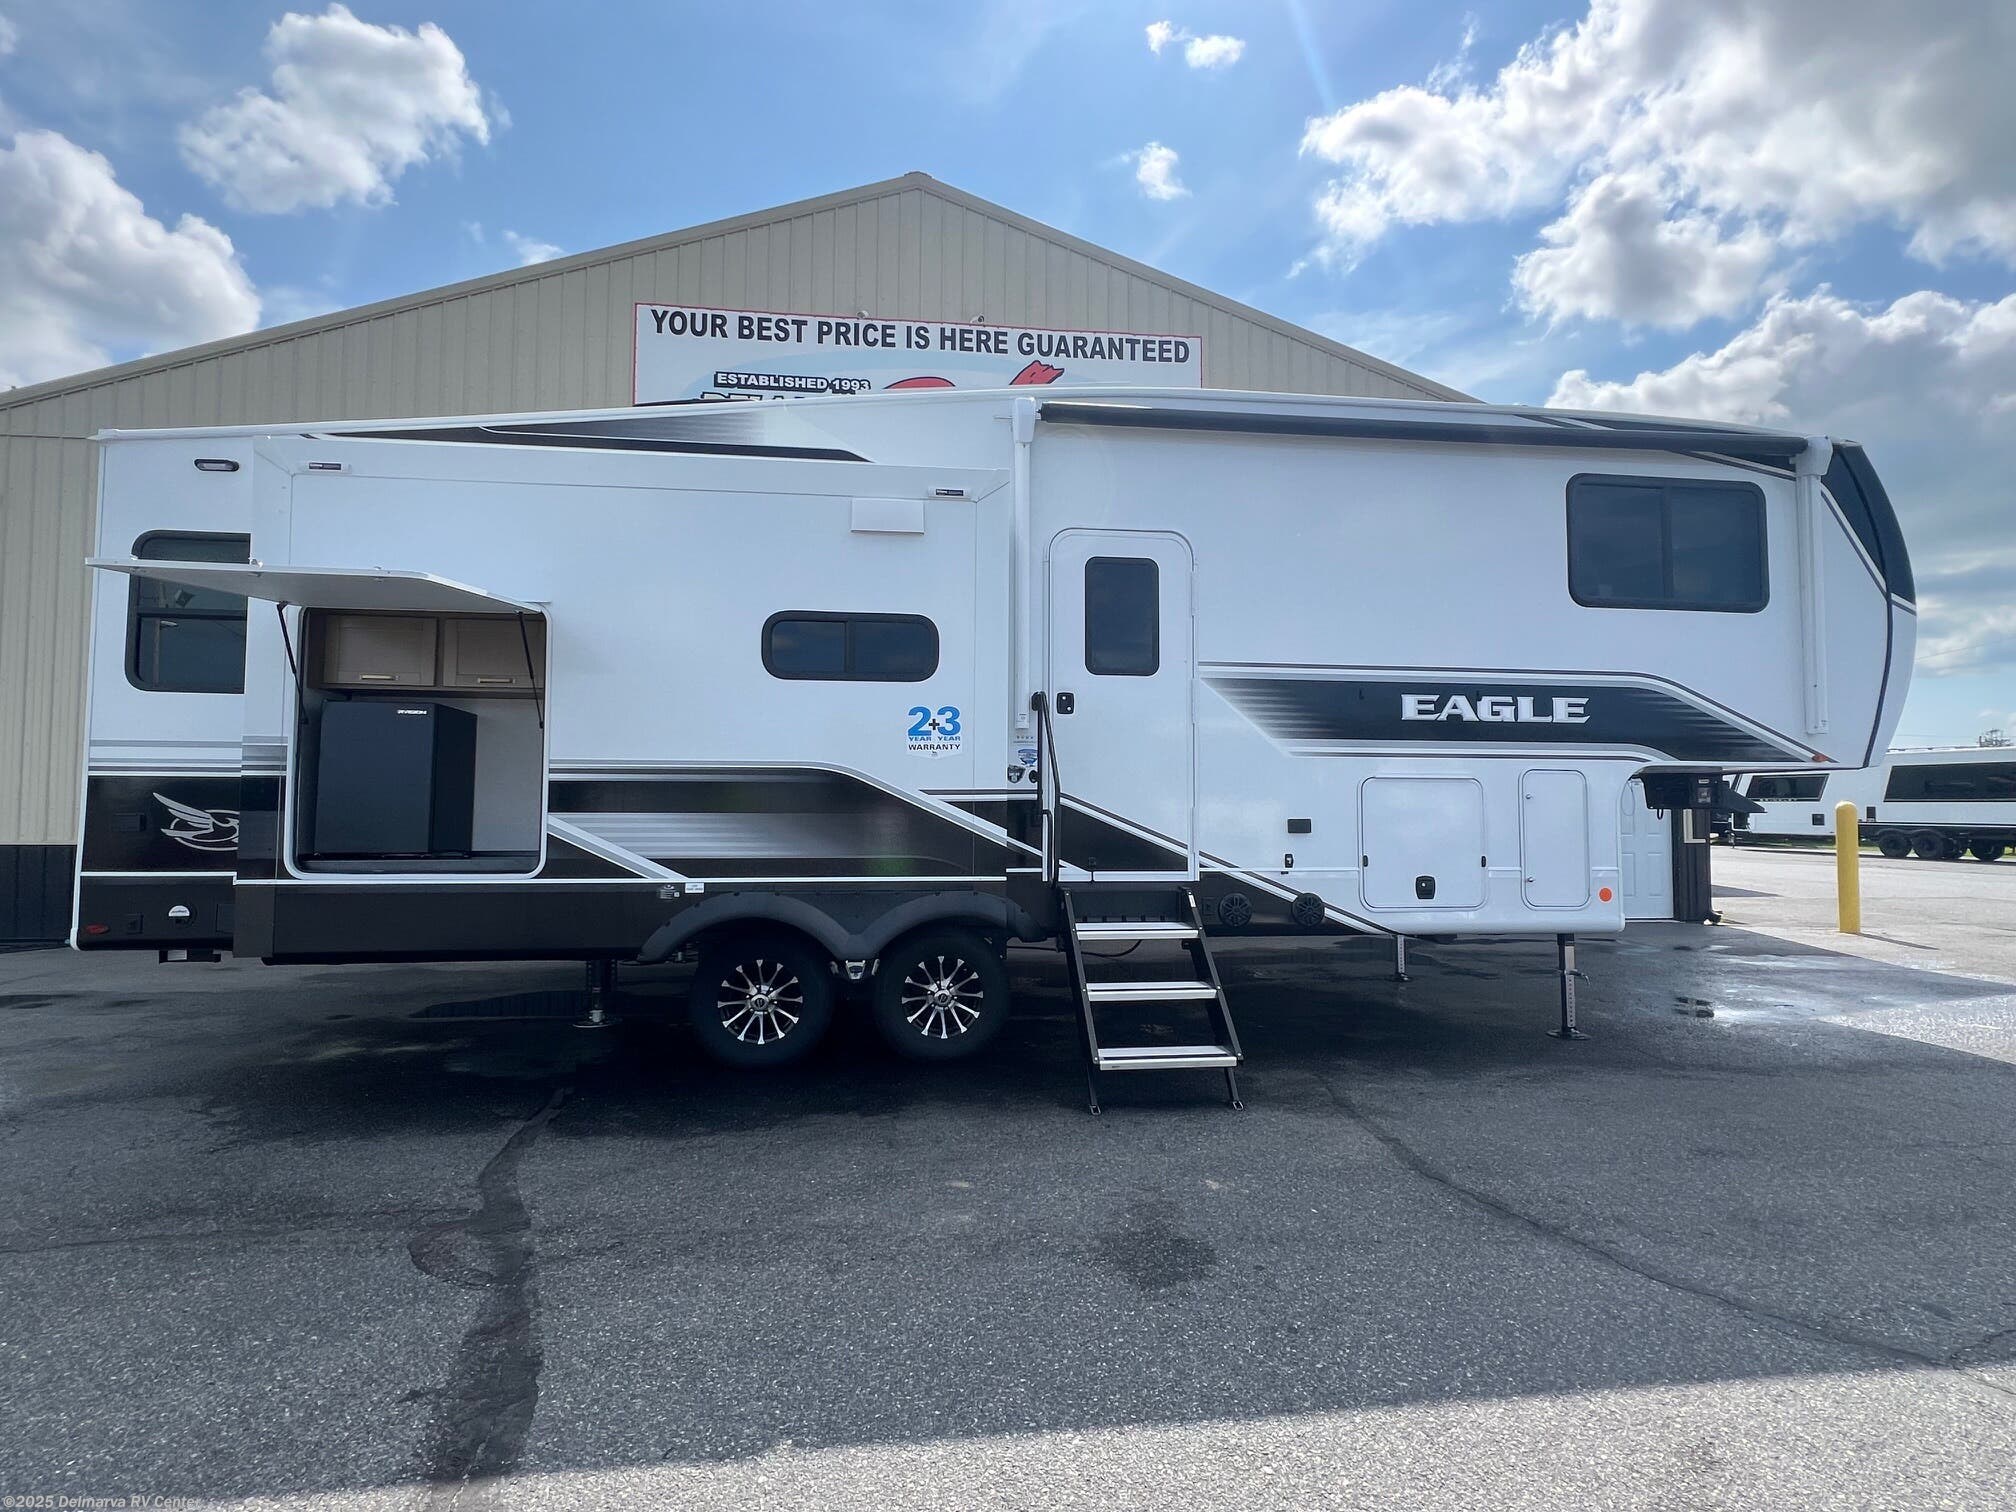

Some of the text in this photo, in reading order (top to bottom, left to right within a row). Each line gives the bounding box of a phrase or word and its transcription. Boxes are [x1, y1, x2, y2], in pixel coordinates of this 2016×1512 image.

[651, 309, 1190, 362] YOUR BEST PRICE IS HERE GUARANTEED
[716, 372, 871, 391] ESTABLISHED 1993
[1401, 694, 1591, 724] EAGLE
